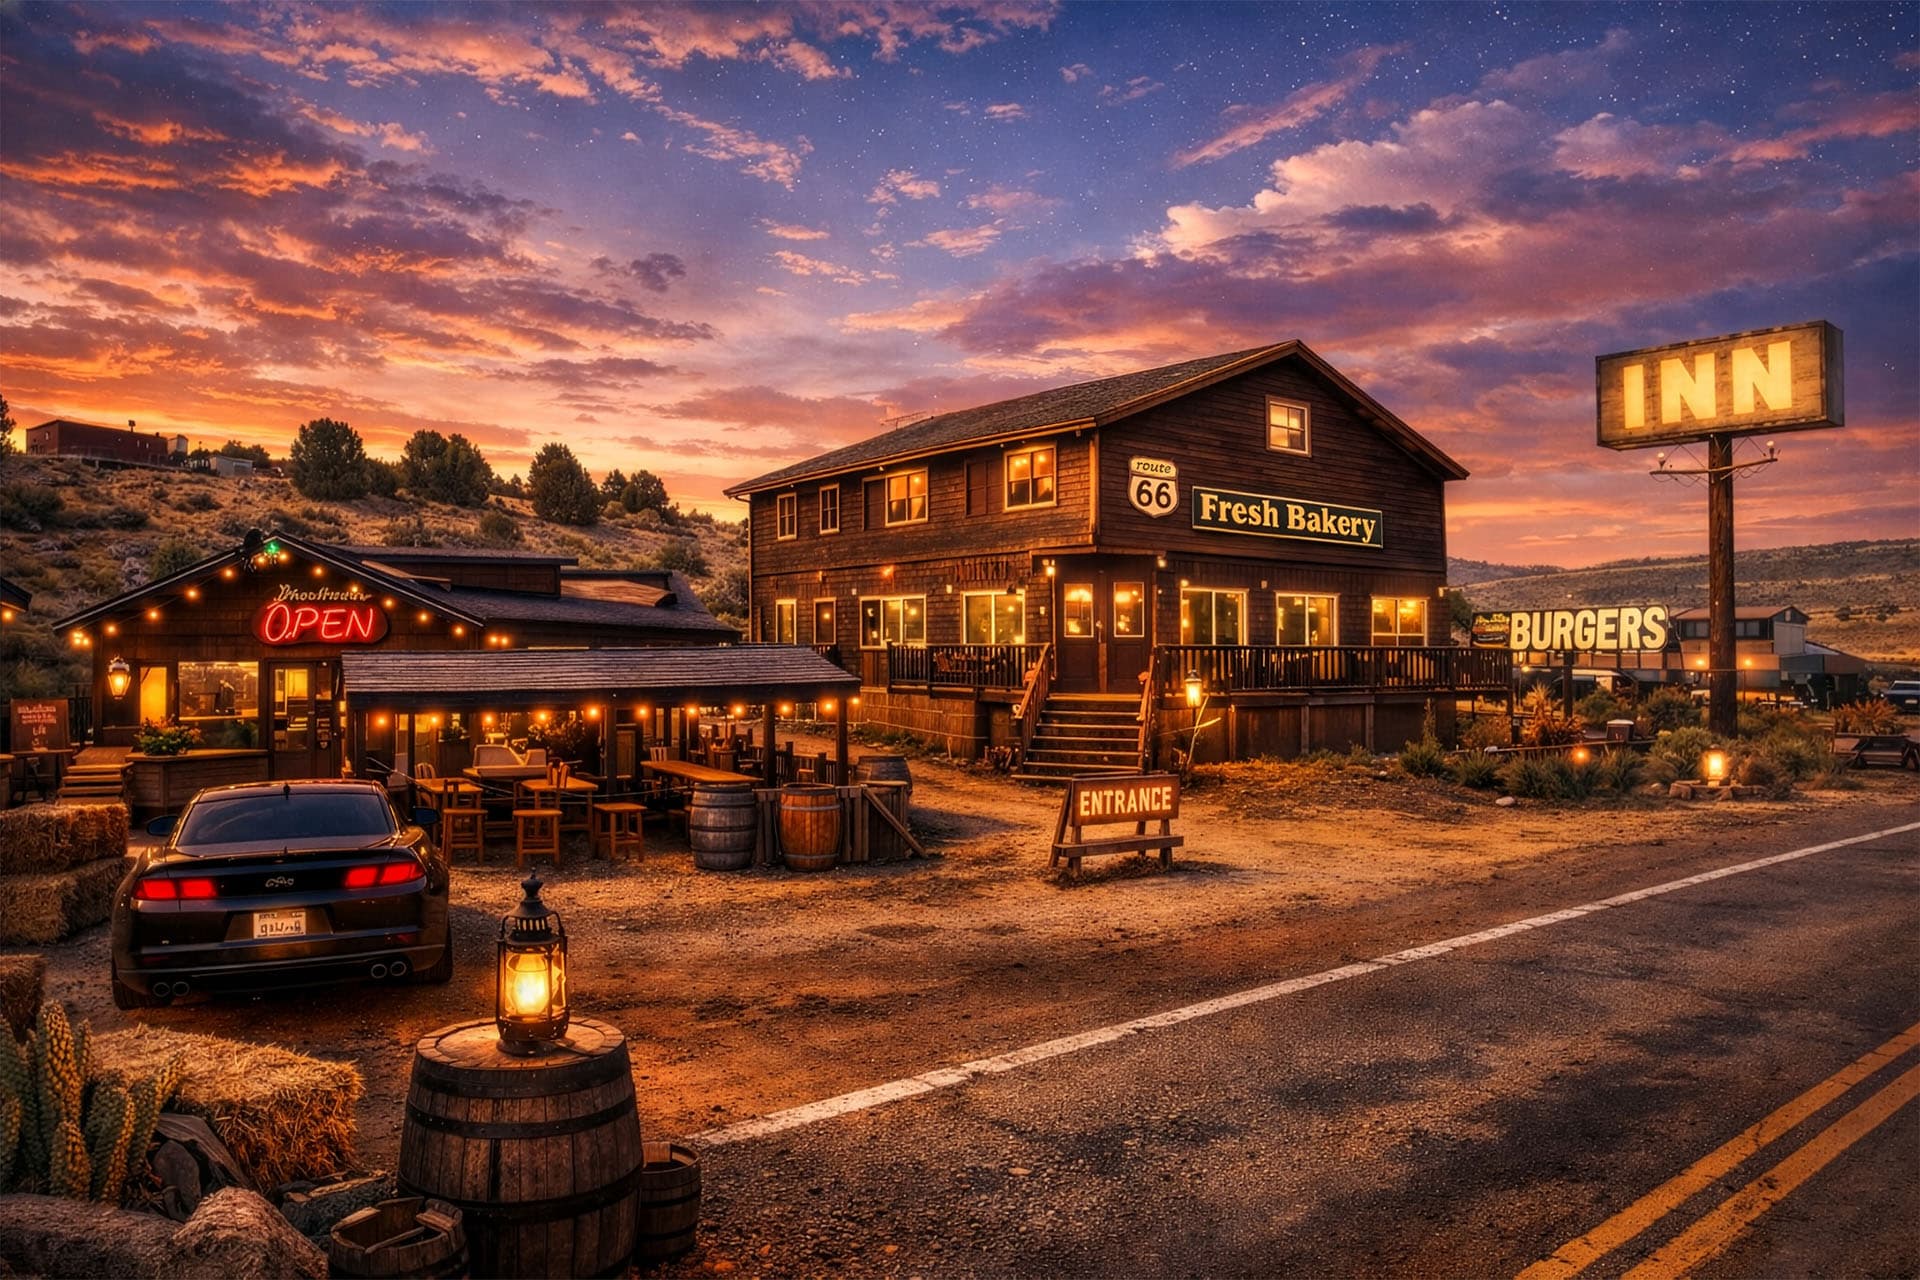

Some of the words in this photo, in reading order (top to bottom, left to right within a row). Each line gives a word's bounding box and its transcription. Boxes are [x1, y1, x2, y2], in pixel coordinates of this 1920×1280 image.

[1623, 340, 1792, 429] INN
[1136, 460, 1172, 474] route
[1136, 479, 1172, 509] 66
[1200, 493, 1280, 528] Fresh
[1286, 503, 1376, 543] Bakery
[265, 603, 373, 642] OPEN
[1509, 605, 1666, 650] BURGERS
[1080, 786, 1172, 816] ENTRANCE
